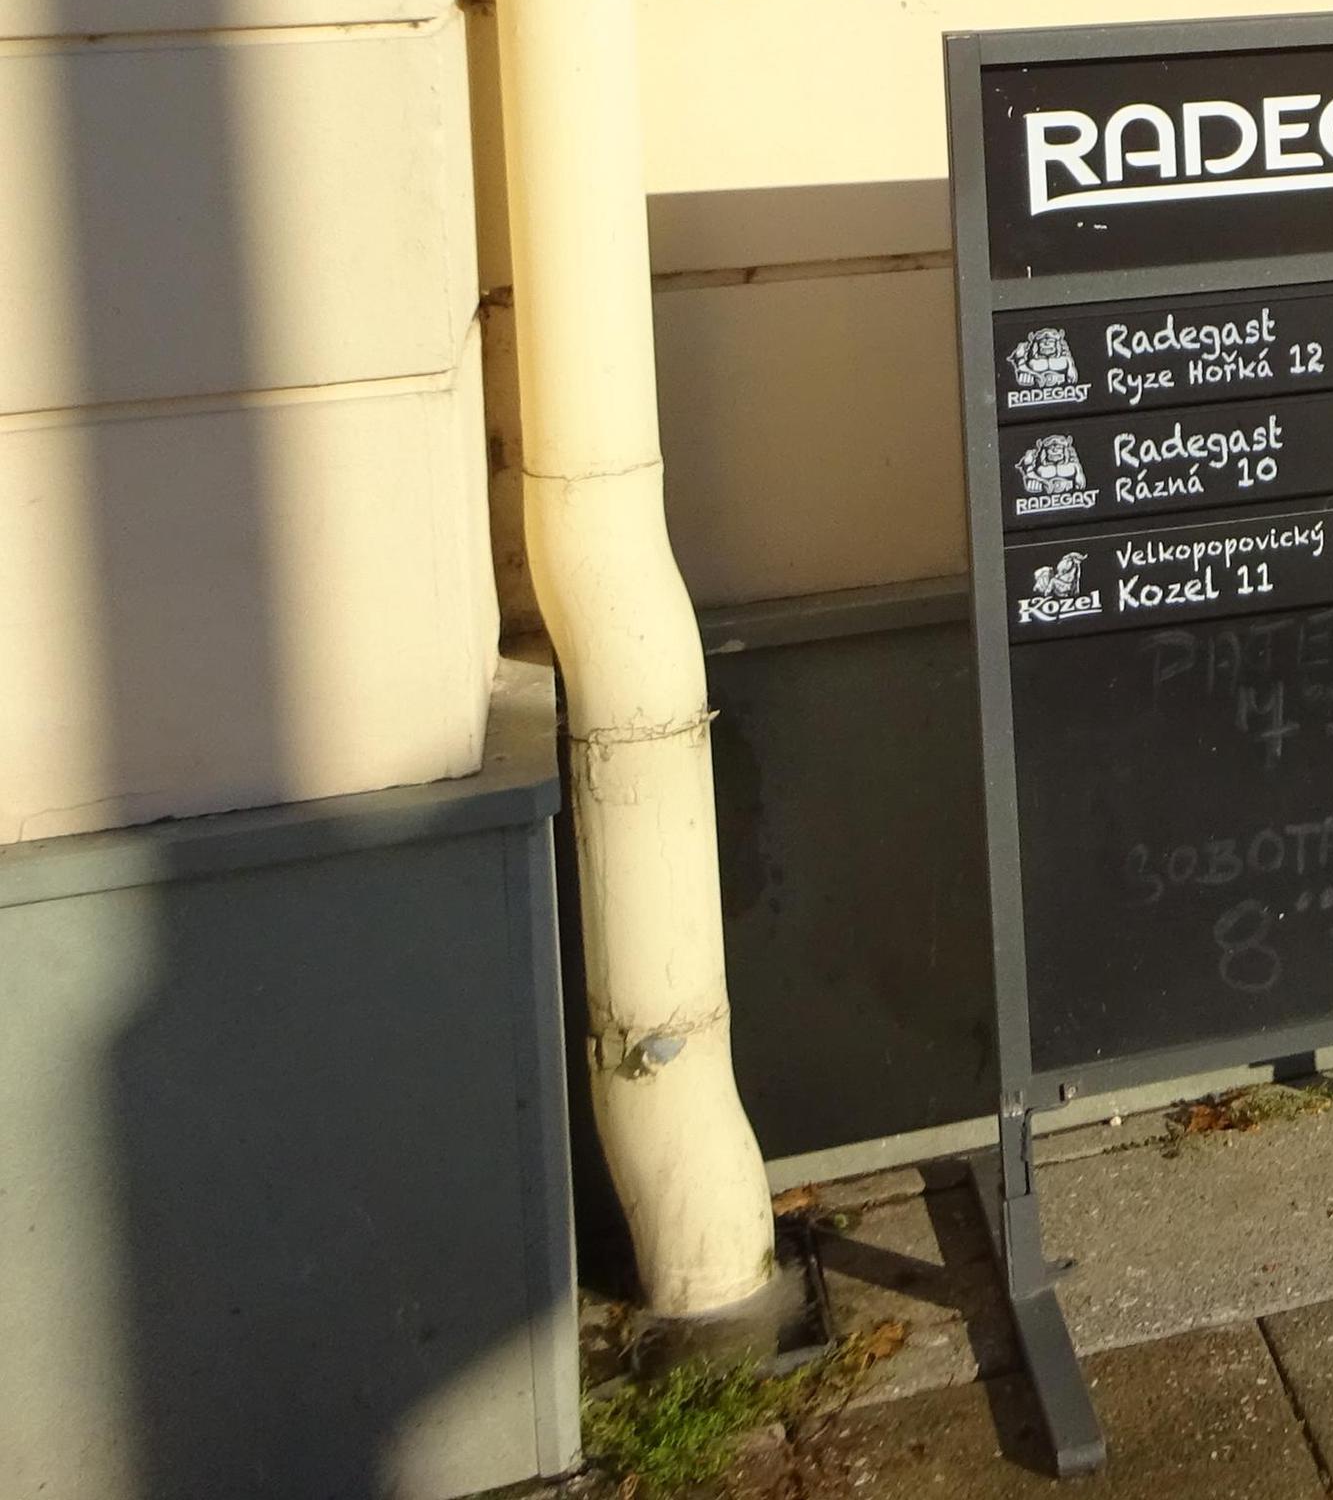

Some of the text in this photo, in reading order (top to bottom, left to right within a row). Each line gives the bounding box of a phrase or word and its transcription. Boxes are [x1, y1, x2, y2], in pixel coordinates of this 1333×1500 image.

[1106, 308, 1276, 361] Radegast
[1008, 384, 1091, 408] RADEGAST
[1107, 342, 1326, 405] Ryze Hořká 12
[1114, 415, 1283, 470] Radegast
[1016, 489, 1099, 515] RADEGAST
[1116, 456, 1278, 504] Rázná 10
[1116, 521, 1325, 571] Velkopopovický
[1018, 590, 1103, 623] Kozel
[1117, 562, 1273, 612] Kozel 11
